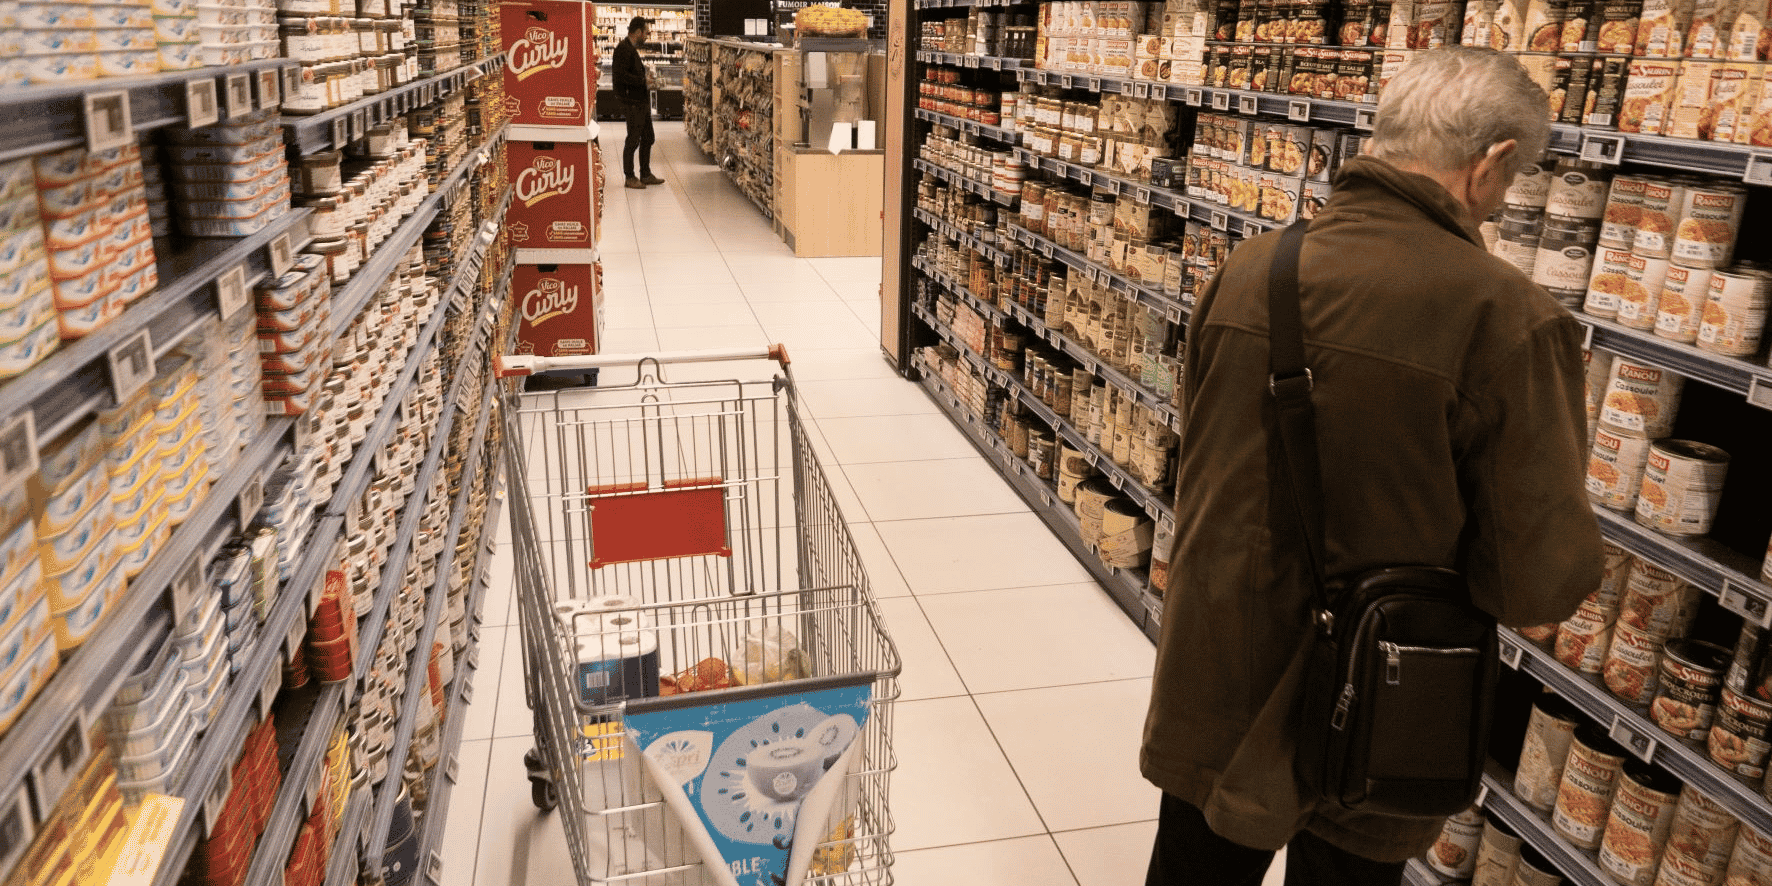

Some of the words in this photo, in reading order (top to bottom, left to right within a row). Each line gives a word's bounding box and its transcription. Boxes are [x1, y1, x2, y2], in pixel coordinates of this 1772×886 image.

[529, 30, 547, 41] Vico
[507, 31, 569, 74] Curly
[536, 159, 554, 169] Vico
[516, 159, 575, 201] Curly
[1614, 181, 1645, 193] RANOU
[1695, 194, 1733, 206] RANOU
[1690, 210, 1730, 220] Cassoulet
[541, 281, 558, 290] Vico
[522, 281, 578, 321] Curly
[1620, 365, 1659, 381] RANOU
[1615, 381, 1658, 395] Cassoulet
[1731, 695, 1771, 719] SAURIN
[1570, 754, 1611, 780] RANOU
[1565, 769, 1610, 796] Cassoulet
[726, 857, 761, 877] BLE
